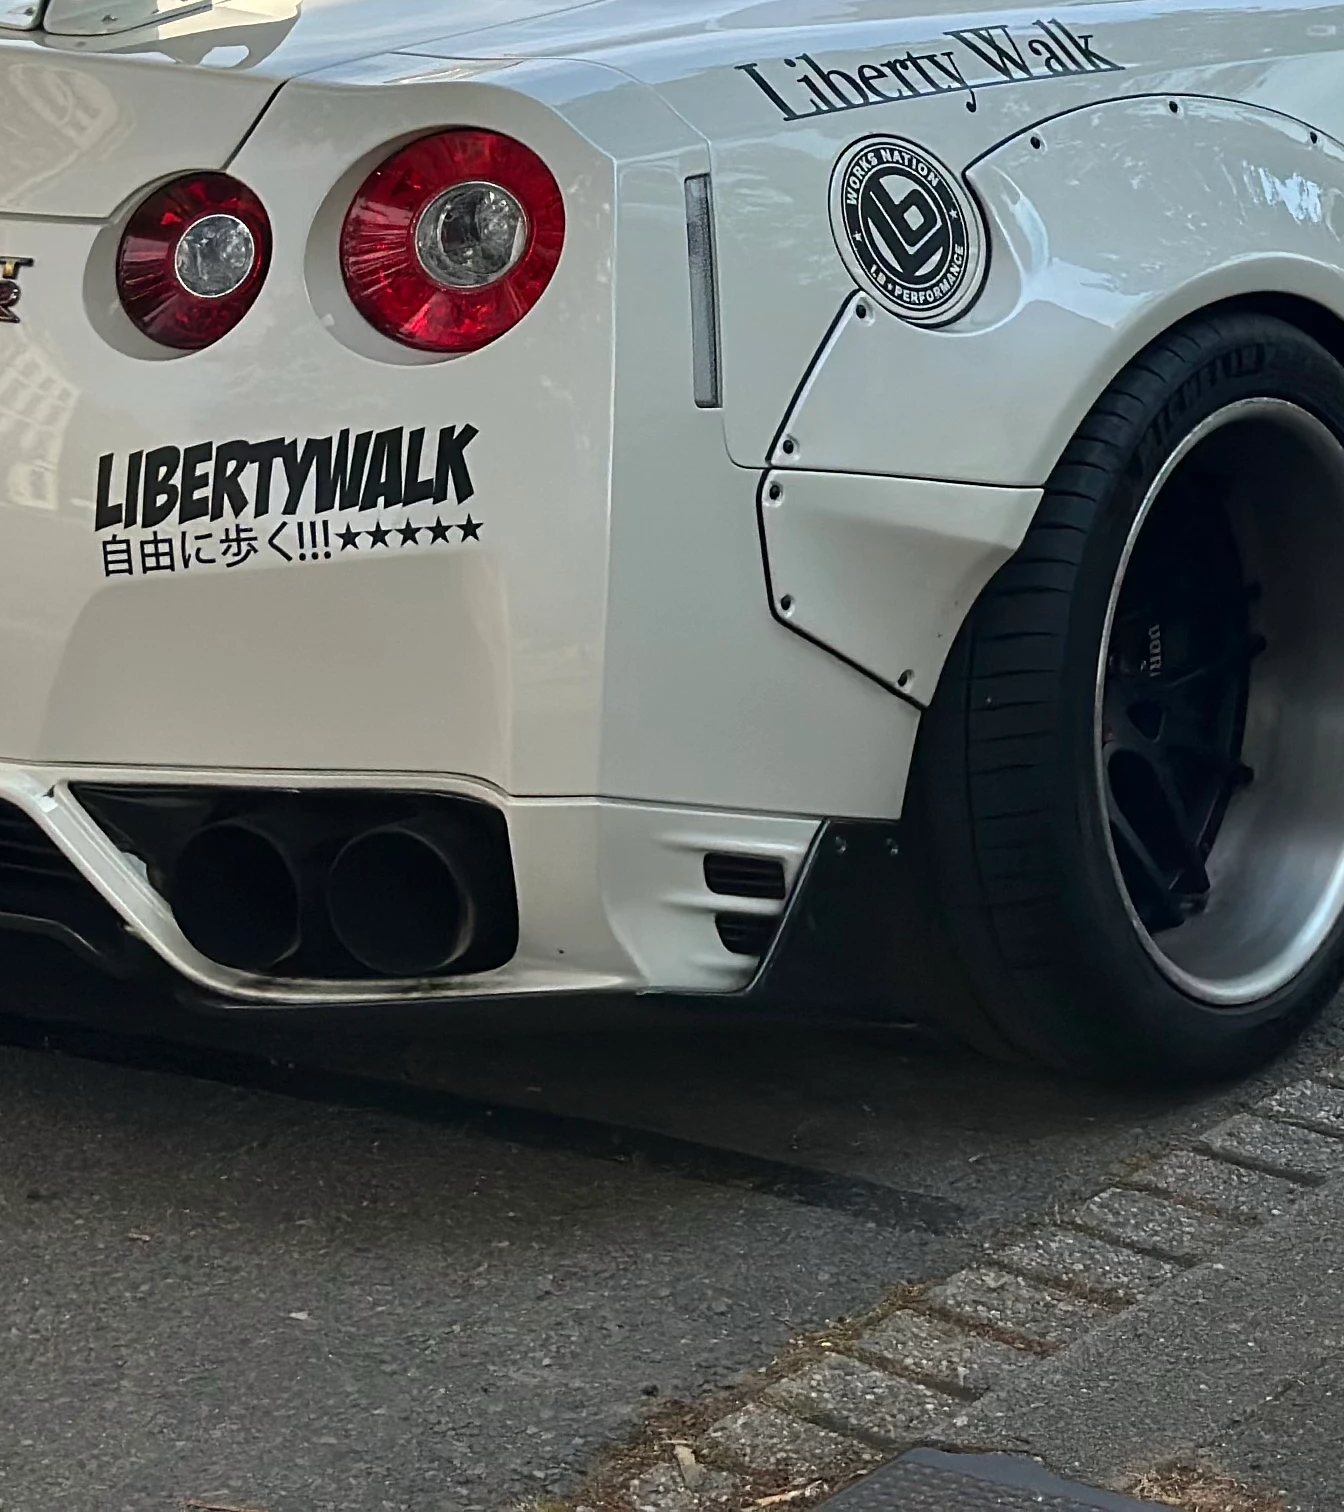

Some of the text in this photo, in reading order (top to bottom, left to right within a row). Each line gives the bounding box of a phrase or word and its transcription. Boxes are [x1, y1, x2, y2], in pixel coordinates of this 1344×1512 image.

[734, 18, 1126, 121] Liberty Walk
[846, 149, 942, 205] WORKS NATION
[894, 243, 964, 304] PERFORMANCE
[94, 422, 480, 532] LIBERTYWALK
